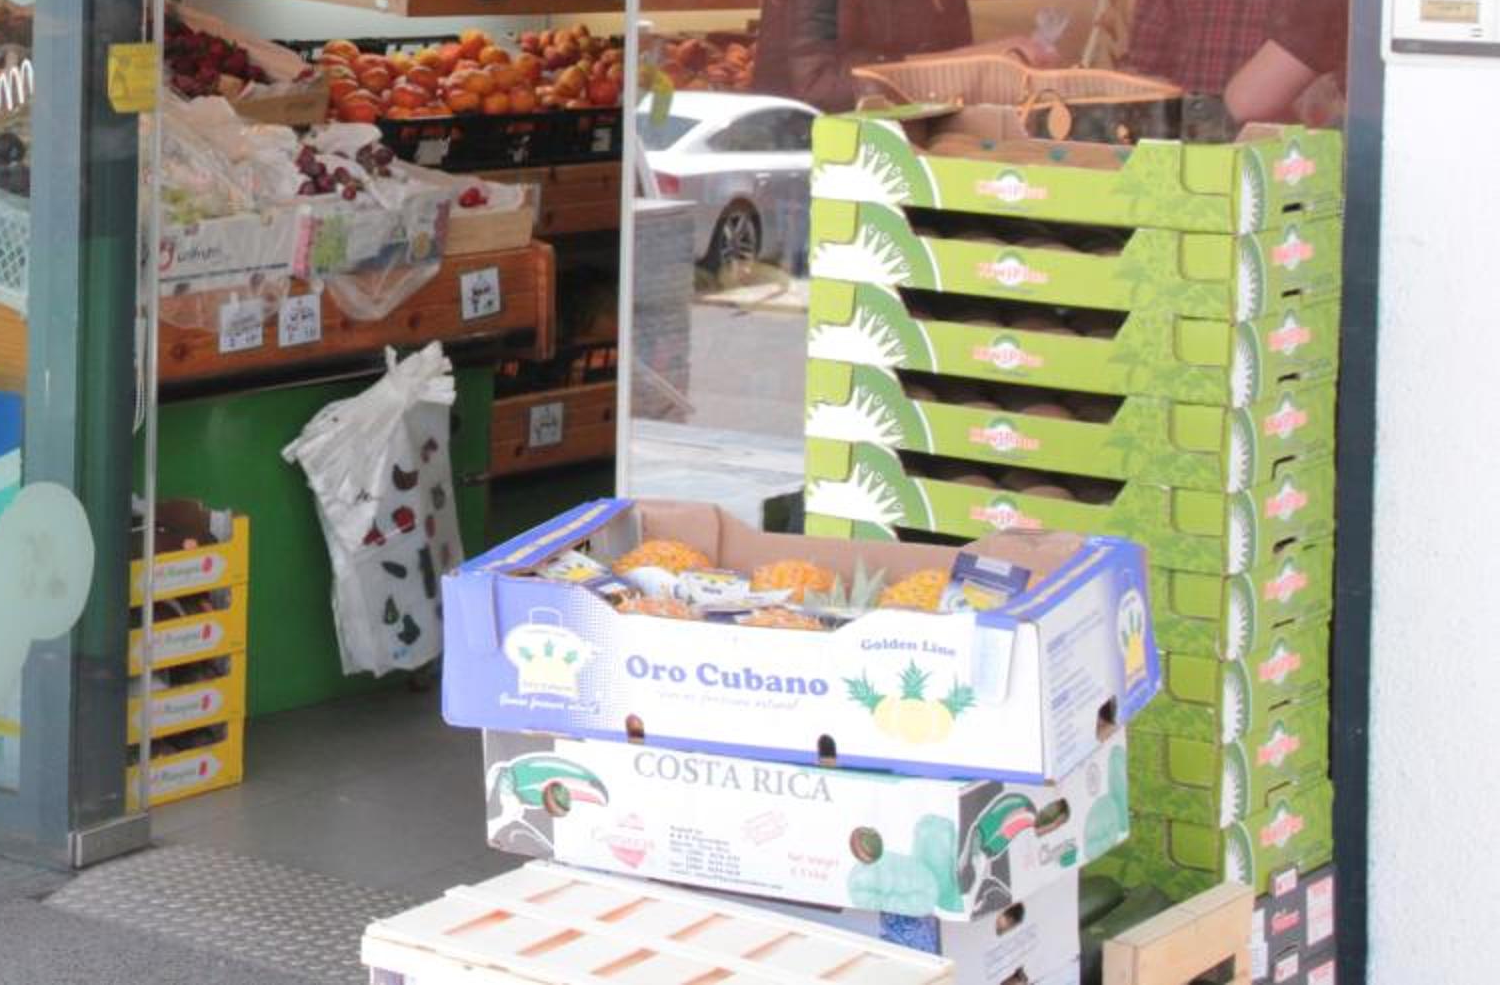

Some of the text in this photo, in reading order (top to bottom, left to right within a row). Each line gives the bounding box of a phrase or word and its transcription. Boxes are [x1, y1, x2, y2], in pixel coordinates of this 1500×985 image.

[860, 638, 917, 651] Golden
[626, 654, 830, 697] Oro Cubano
[634, 751, 834, 802] COSTA RICA
